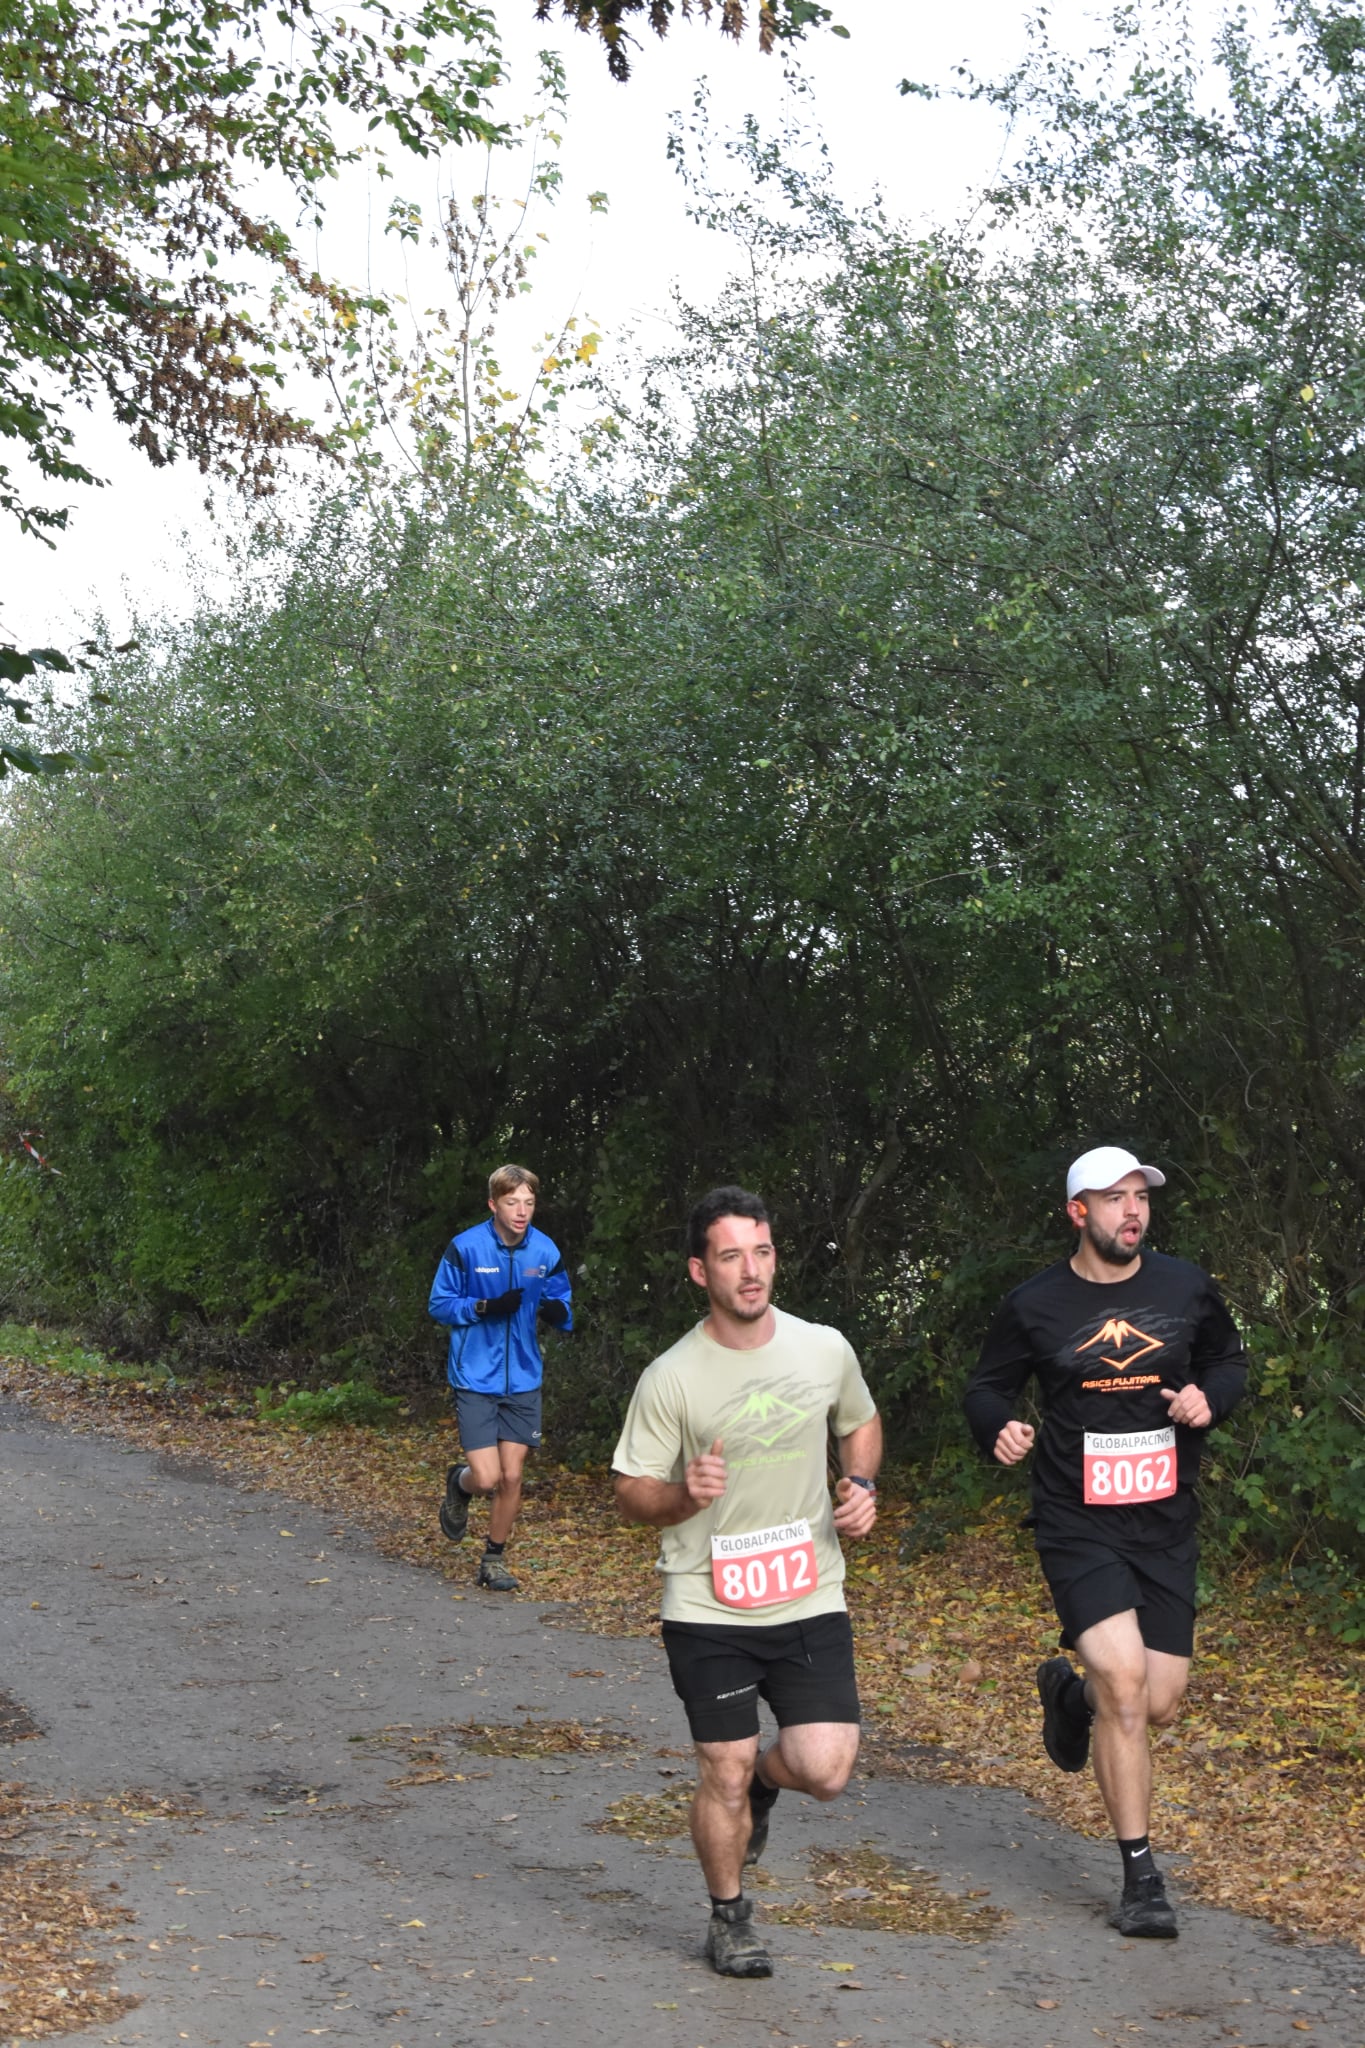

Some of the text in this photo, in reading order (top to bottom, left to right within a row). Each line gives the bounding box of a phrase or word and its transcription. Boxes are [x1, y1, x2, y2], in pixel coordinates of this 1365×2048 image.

[1082, 1375, 1161, 1388] ASICS FUJITRAIL
[1092, 1431, 1170, 1449] GLOBALPACING
[1092, 1455, 1171, 1496] 8062
[720, 1524, 805, 1552] GLOBALPACING
[722, 1549, 812, 1601] 8012
